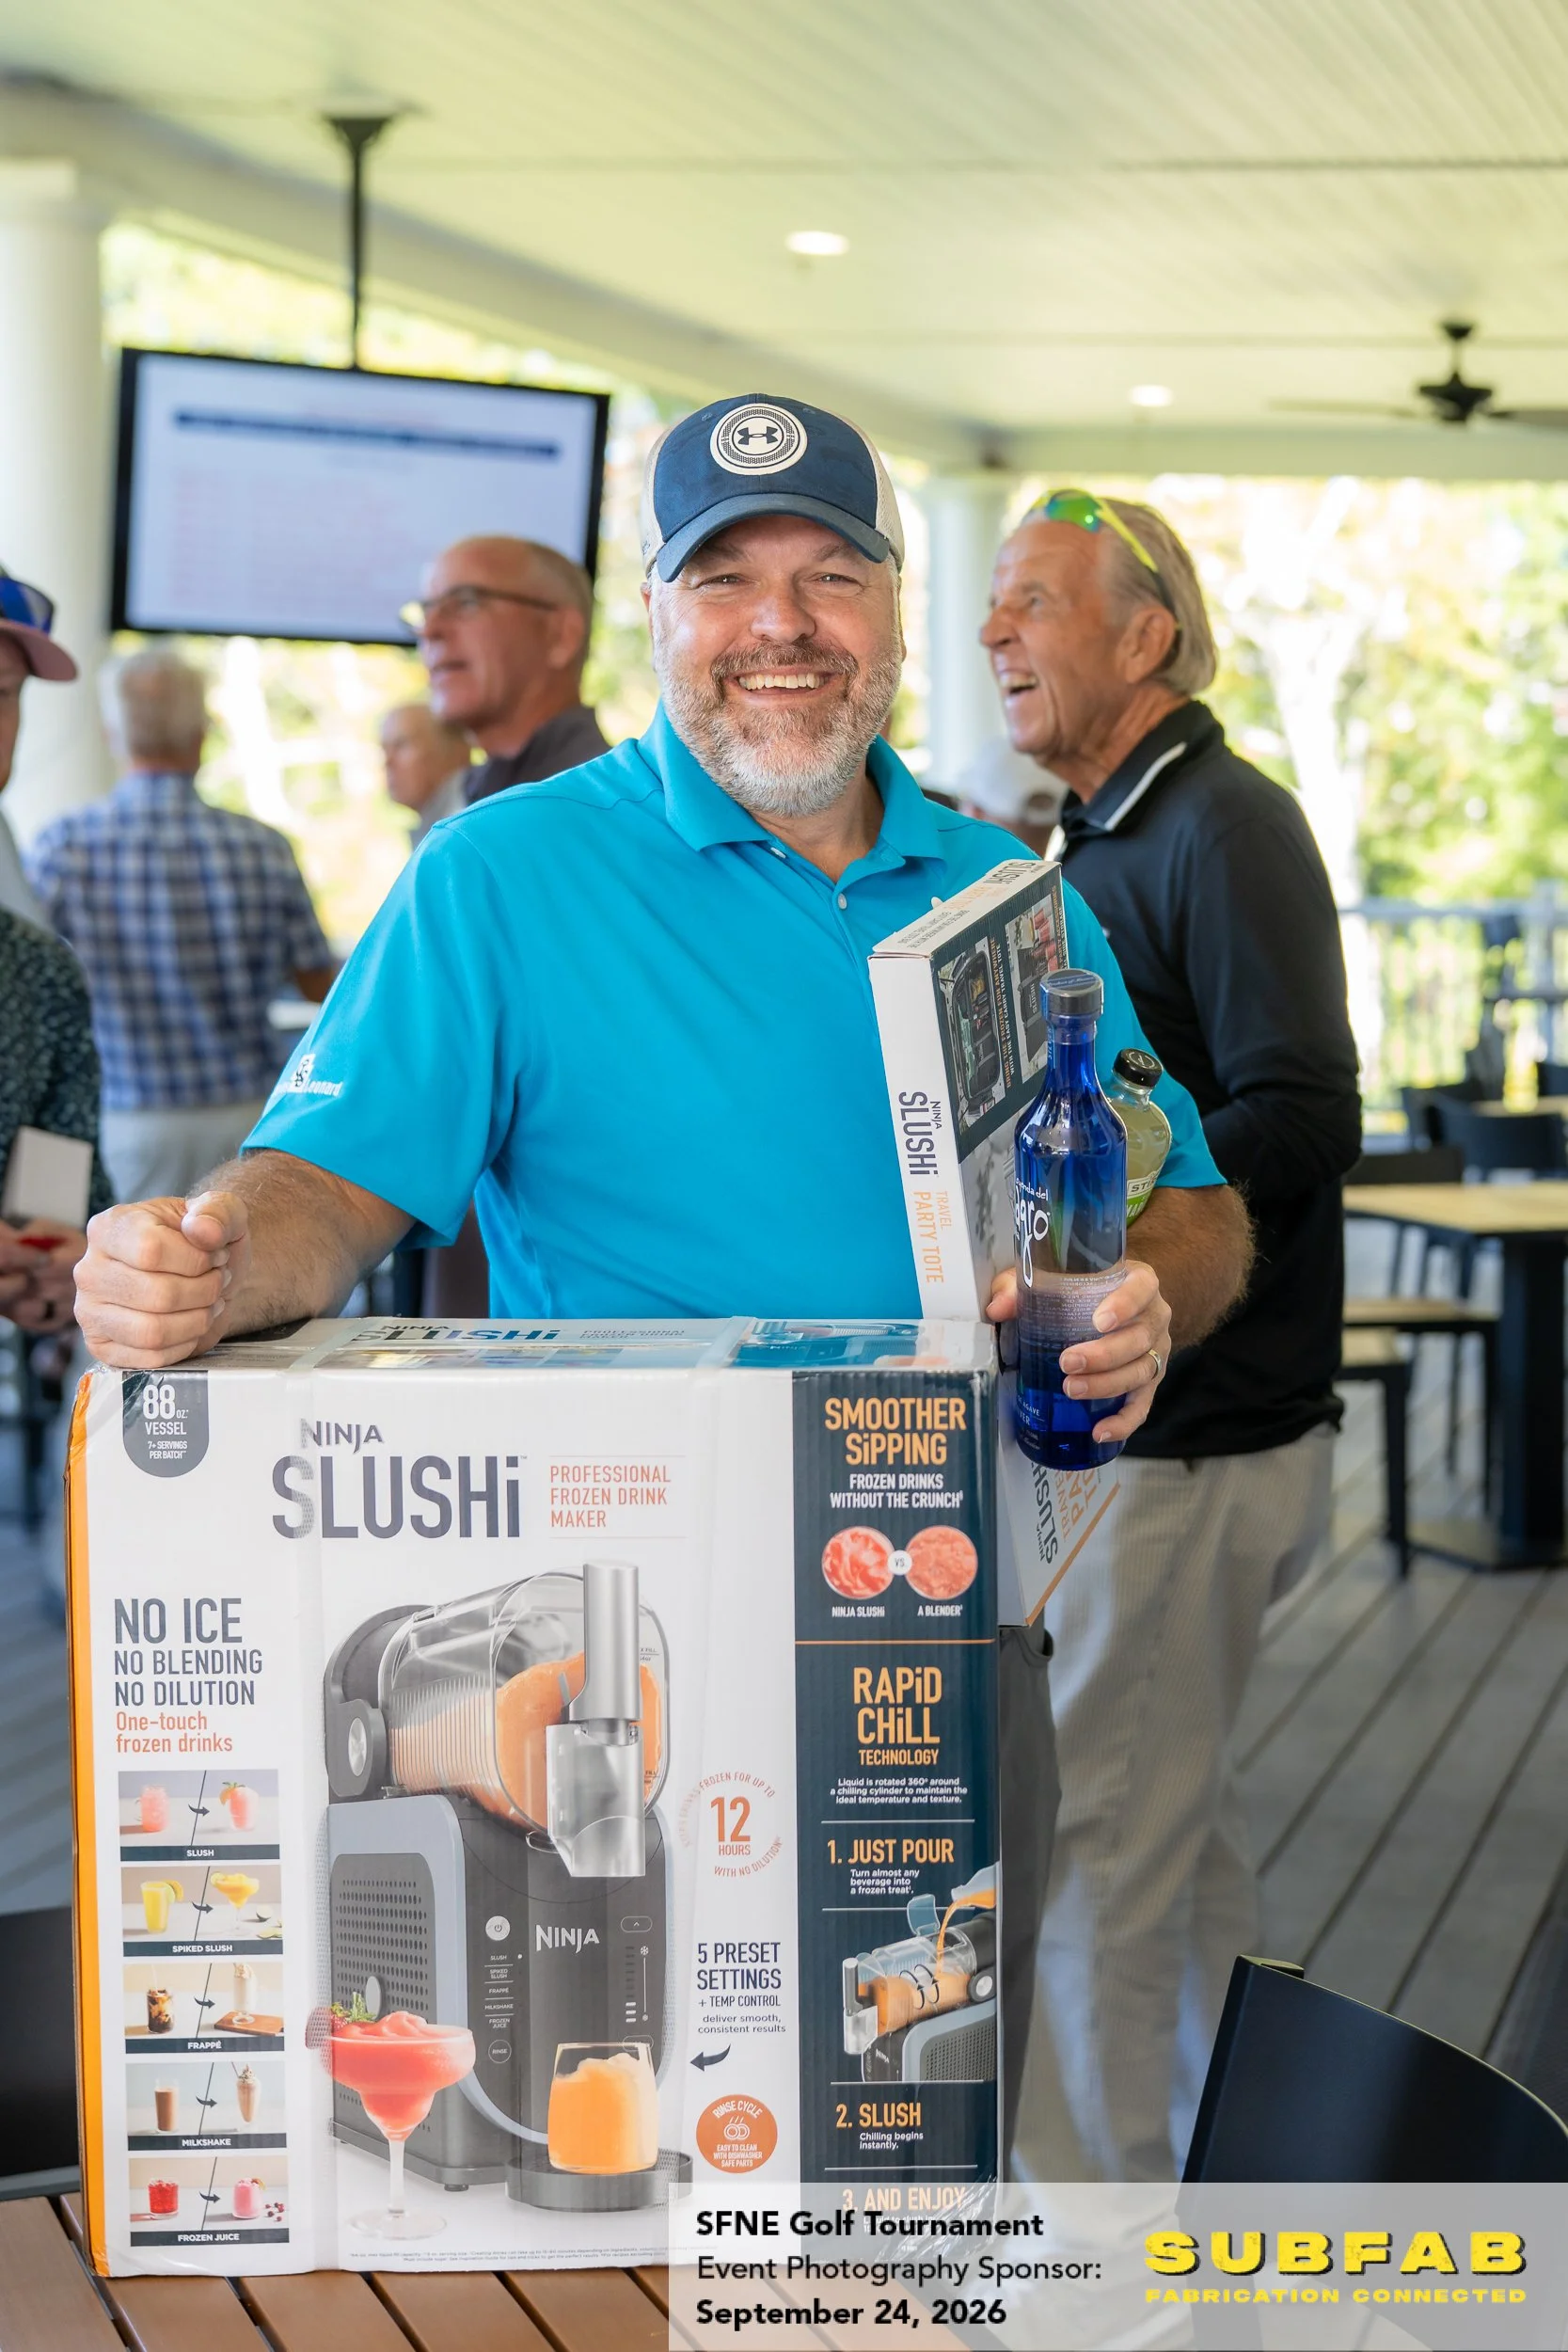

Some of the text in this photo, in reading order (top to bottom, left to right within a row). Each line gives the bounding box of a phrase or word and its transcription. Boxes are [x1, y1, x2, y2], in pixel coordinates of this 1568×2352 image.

[930, 1101, 942, 1129] NINJA
[898, 1091, 938, 1175] SLUSHi
[1036, 1187, 1049, 1201] del
[935, 1190, 952, 1230] TRAVEL
[913, 1191, 944, 1283] PARTY TOTE
[352, 1329, 561, 1341] SLUSHi
[143, 1384, 176, 1420] 88
[824, 1397, 967, 1430] SMOOTHER
[145, 1422, 187, 1436] VESSEL
[300, 1418, 384, 1454] NINJA
[148, 1440, 188, 1450] 7+ SERVINGS
[150, 1451, 162, 1459] PER
[550, 1465, 671, 1484] PROFESSIONAL
[849, 1473, 943, 1489] FROZEN DRINKS
[550, 1487, 667, 1505] FROZEN DRINK
[830, 1492, 885, 1509] WITHOUT
[886, 1491, 910, 1508] THE
[551, 1510, 607, 1528] MAKER
[1031, 1462, 1058, 1565] SLUSH
[832, 1607, 856, 1617] NINJA
[917, 1606, 924, 1616] A
[114, 1597, 243, 1644] NO ICE
[114, 1649, 262, 1675] NO BLENDING
[115, 1680, 255, 1707] NO DILUTION
[116, 1710, 208, 1731] One-touch
[116, 1733, 233, 1753] frozen drinks
[859, 1749, 939, 1766] TECHNOLOGY
[699, 1772, 775, 1798] FROZEN FOR UP TO
[837, 1787, 867, 1796] chilling
[869, 1787, 903, 1796] cylinder
[915, 1786, 952, 1794] maintain
[954, 1786, 967, 1794] the
[838, 1777, 864, 1788] Liquid
[866, 1777, 873, 1786] is
[875, 1777, 906, 1786] rotated
[929, 1777, 959, 1786] around
[858, 1796, 911, 1804] temperature
[912, 1795, 927, 1804] and
[929, 1795, 961, 1804] texture.
[710, 1795, 751, 1842] 12
[719, 1844, 751, 1856] HOURS
[827, 1838, 955, 1864] 1. JUST POUR
[714, 1866, 736, 1877] WITH
[738, 1867, 751, 1876] NO
[850, 1868, 920, 1879] Turn almost any
[850, 1877, 911, 1886] beverage into
[858, 1885, 886, 1894] frozen
[535, 1924, 600, 1954] NINJA
[172, 1945, 204, 1953] SPIKED
[698, 1942, 781, 1963] 5 PRESET
[697, 1968, 782, 1990] SETTINGS
[709, 1995, 735, 2007] TEMP
[737, 1994, 781, 2007] CONTROL
[703, 2013, 782, 2023] deliver smooth,
[752, 2025, 786, 2033] results
[187, 2040, 222, 2049] FRAPPÉ
[712, 2100, 763, 2119] RINSE CYCLE
[835, 2103, 922, 2128] 2. SLUSH
[182, 2138, 231, 2147] MILKSHAKE
[859, 2131, 924, 2141] Chilling begins
[859, 2140, 899, 2150] instantly.
[721, 2159, 753, 2168] SAFE PARTS
[842, 2186, 966, 2212] 3. AND ENJOY
[178, 2233, 214, 2242] FROZEN
